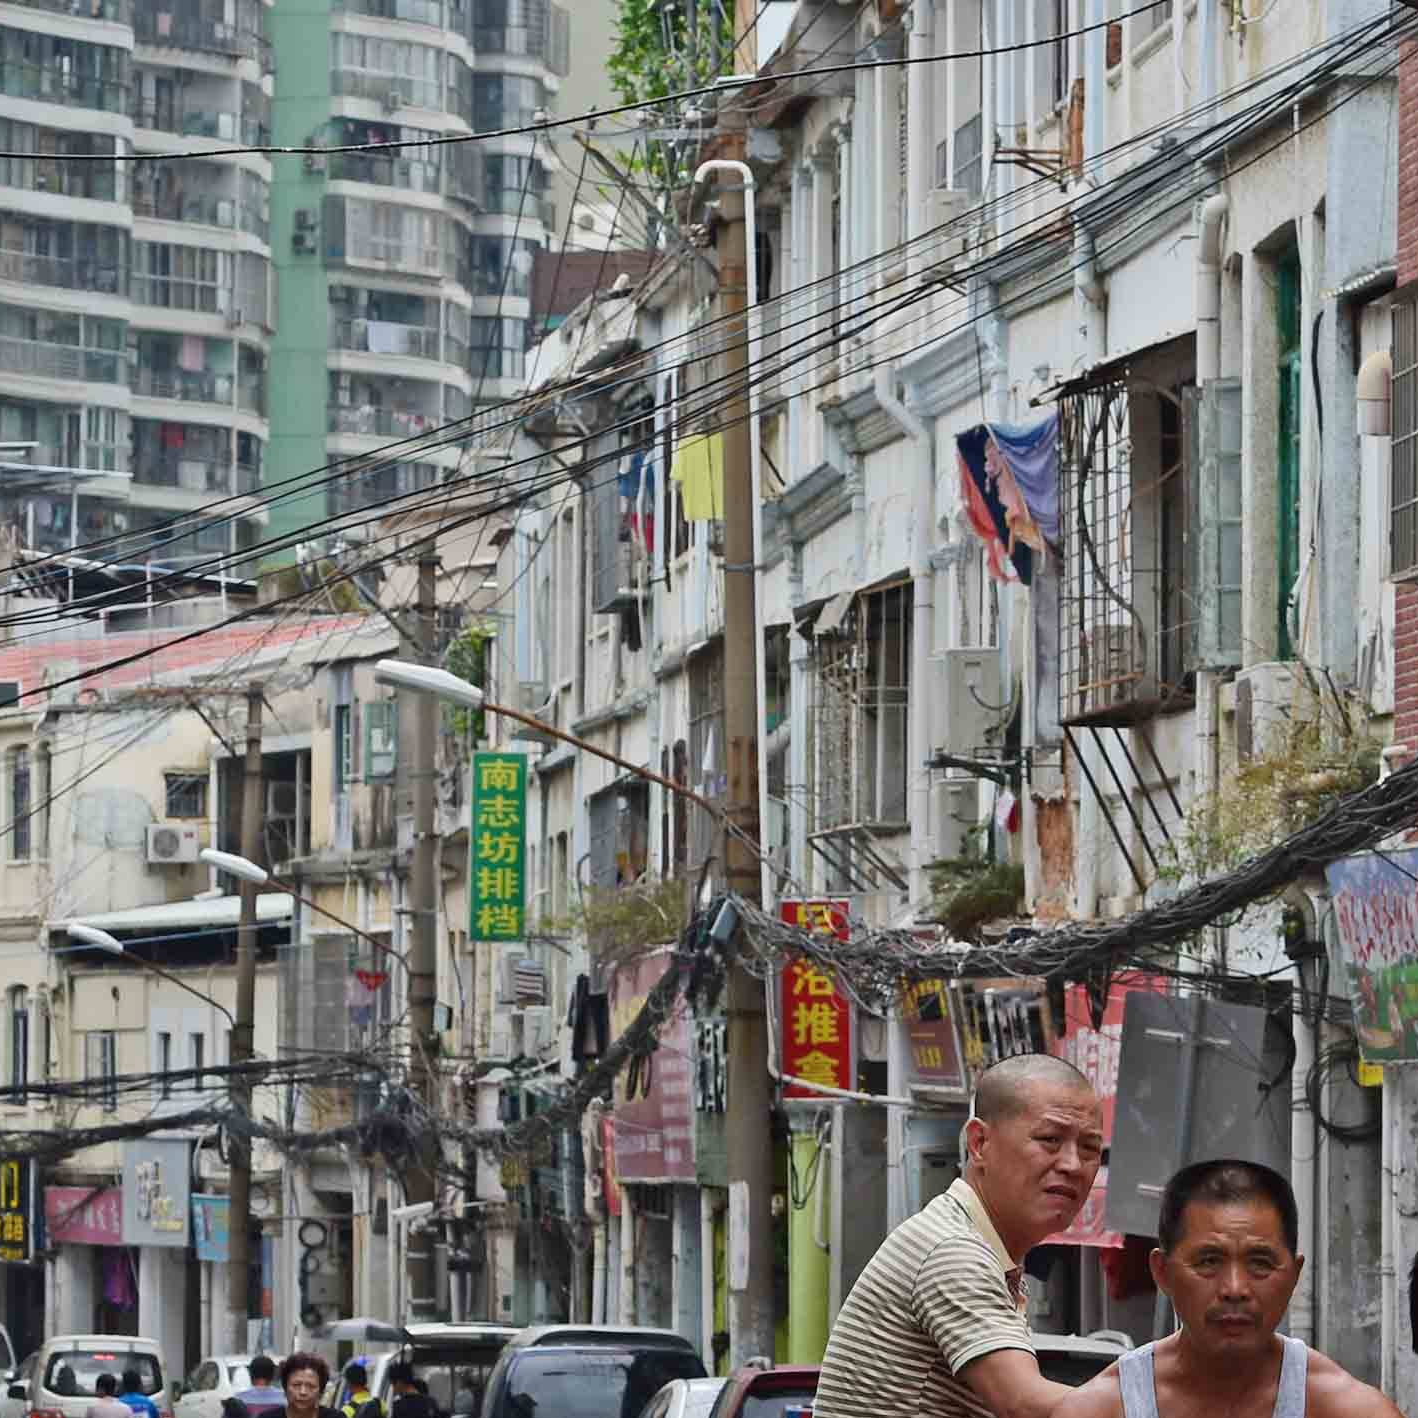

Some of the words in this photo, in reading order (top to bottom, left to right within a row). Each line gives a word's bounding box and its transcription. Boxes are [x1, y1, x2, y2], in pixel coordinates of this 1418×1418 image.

[478, 758, 520, 937] 南志坊排档
